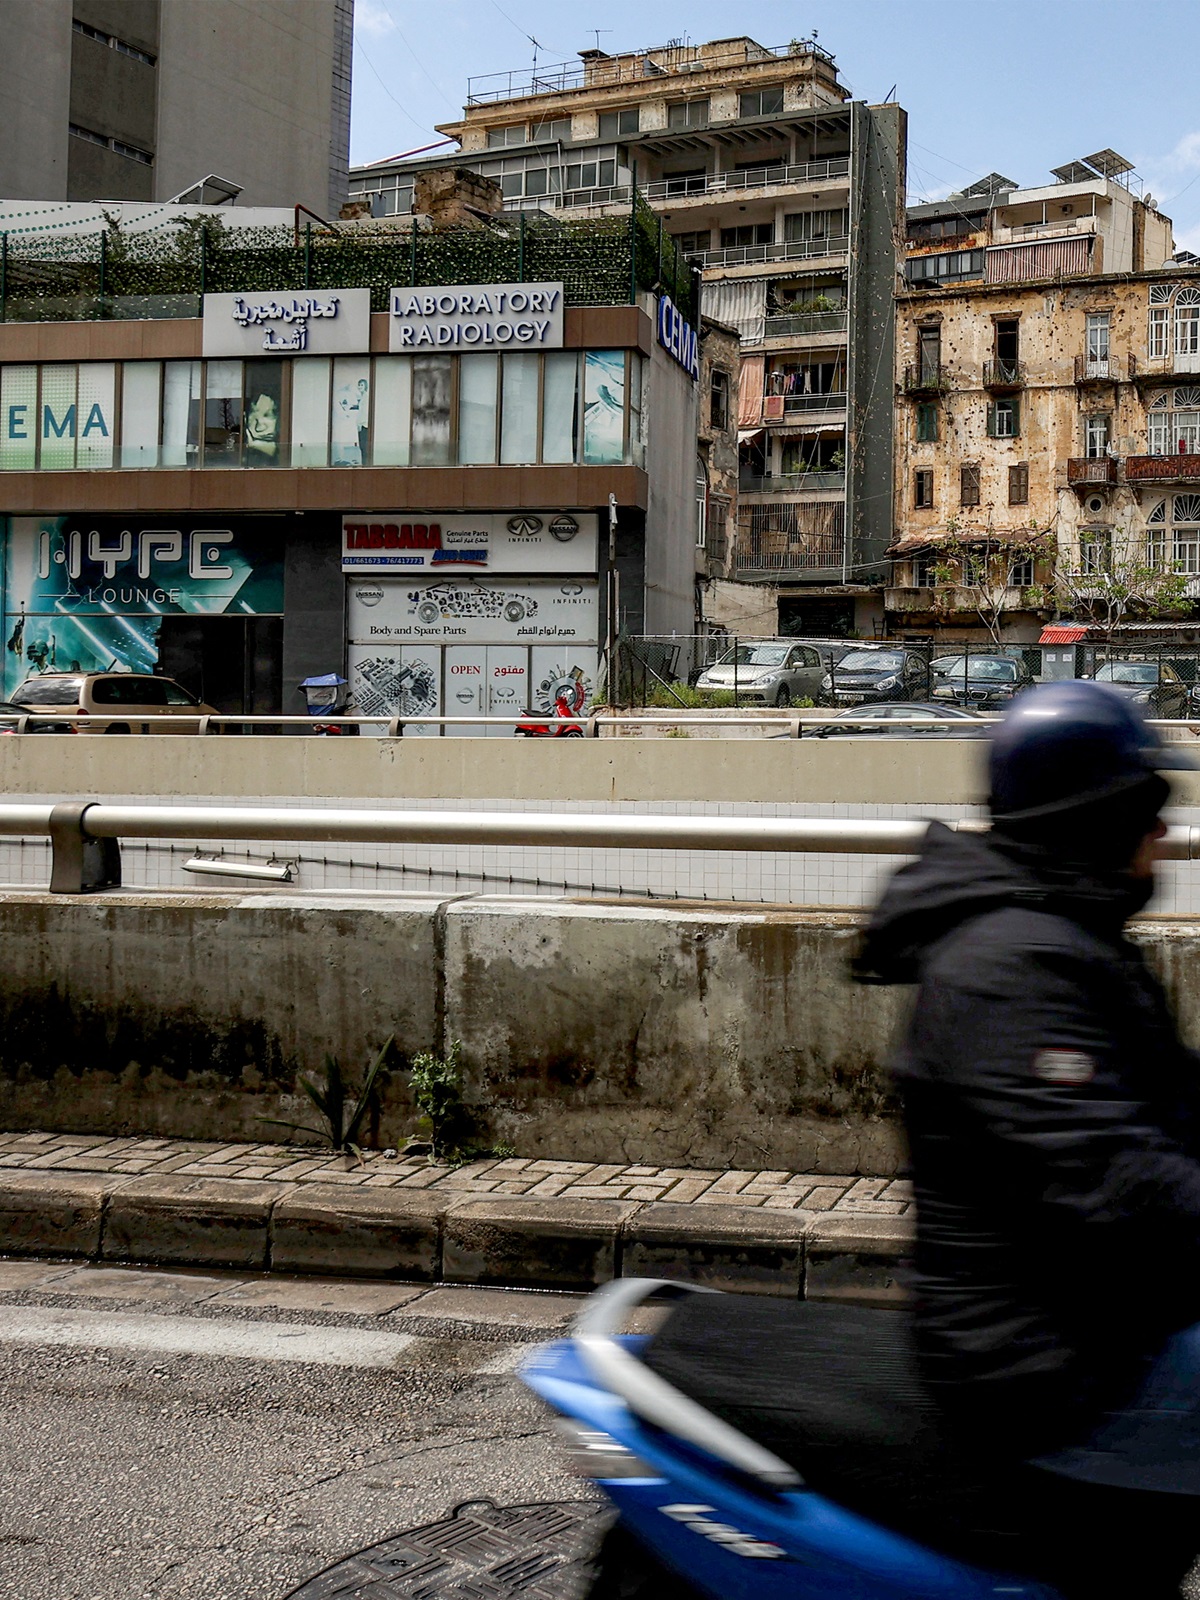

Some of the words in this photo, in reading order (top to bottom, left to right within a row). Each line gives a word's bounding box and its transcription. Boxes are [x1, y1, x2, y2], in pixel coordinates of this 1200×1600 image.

[232, 297, 284, 328] مخبرية
[283, 296, 340, 324] تحاليل
[392, 290, 561, 318] LABORATORY
[262, 325, 308, 351] أشعة
[400, 320, 549, 346] RADIOLOGY
[660, 295, 700, 382] CEMA
[8, 403, 109, 439] EMA
[343, 523, 443, 550] TABBARA
[446, 530, 472, 538] Genuine
[38, 530, 234, 579] HYPE
[89, 588, 181, 604] LOUNGE
[370, 626, 392, 637] Body
[393, 626, 412, 635] and
[413, 626, 442, 637] Spare
[443, 626, 467, 635] Parts
[517, 625, 538, 636] القطع
[557, 628, 576, 637] جميع
[451, 665, 481, 675] OPEN
[494, 665, 525, 677] مفتوح
